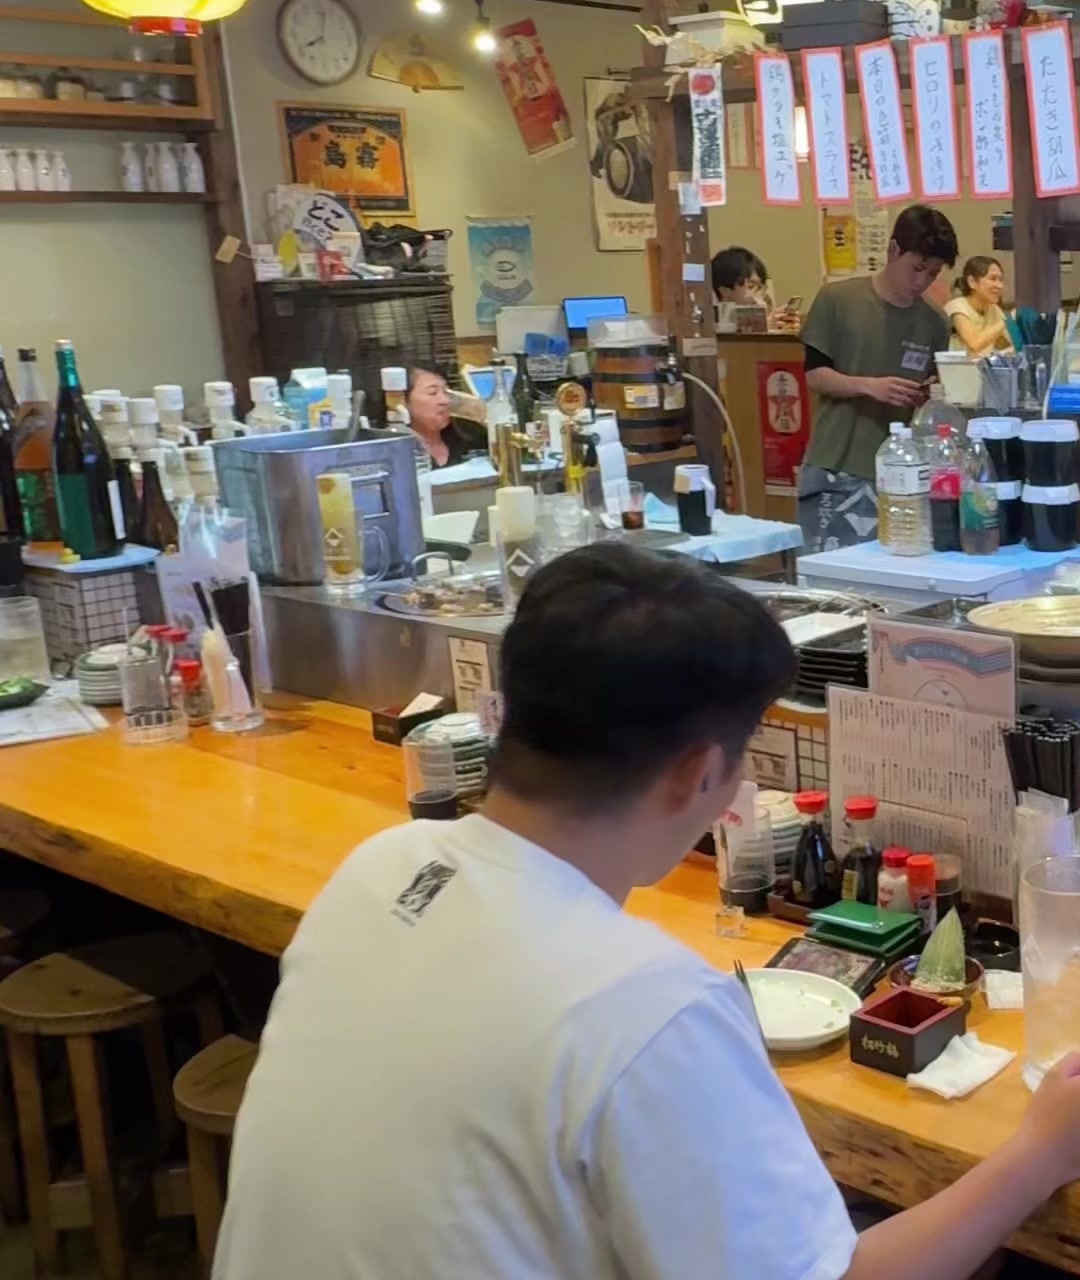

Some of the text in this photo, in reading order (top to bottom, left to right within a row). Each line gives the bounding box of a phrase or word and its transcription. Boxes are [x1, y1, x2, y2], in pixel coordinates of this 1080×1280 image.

[820, 71, 840, 192] トマトスライス
[1039, 55, 1069, 184] たたき胡瓜
